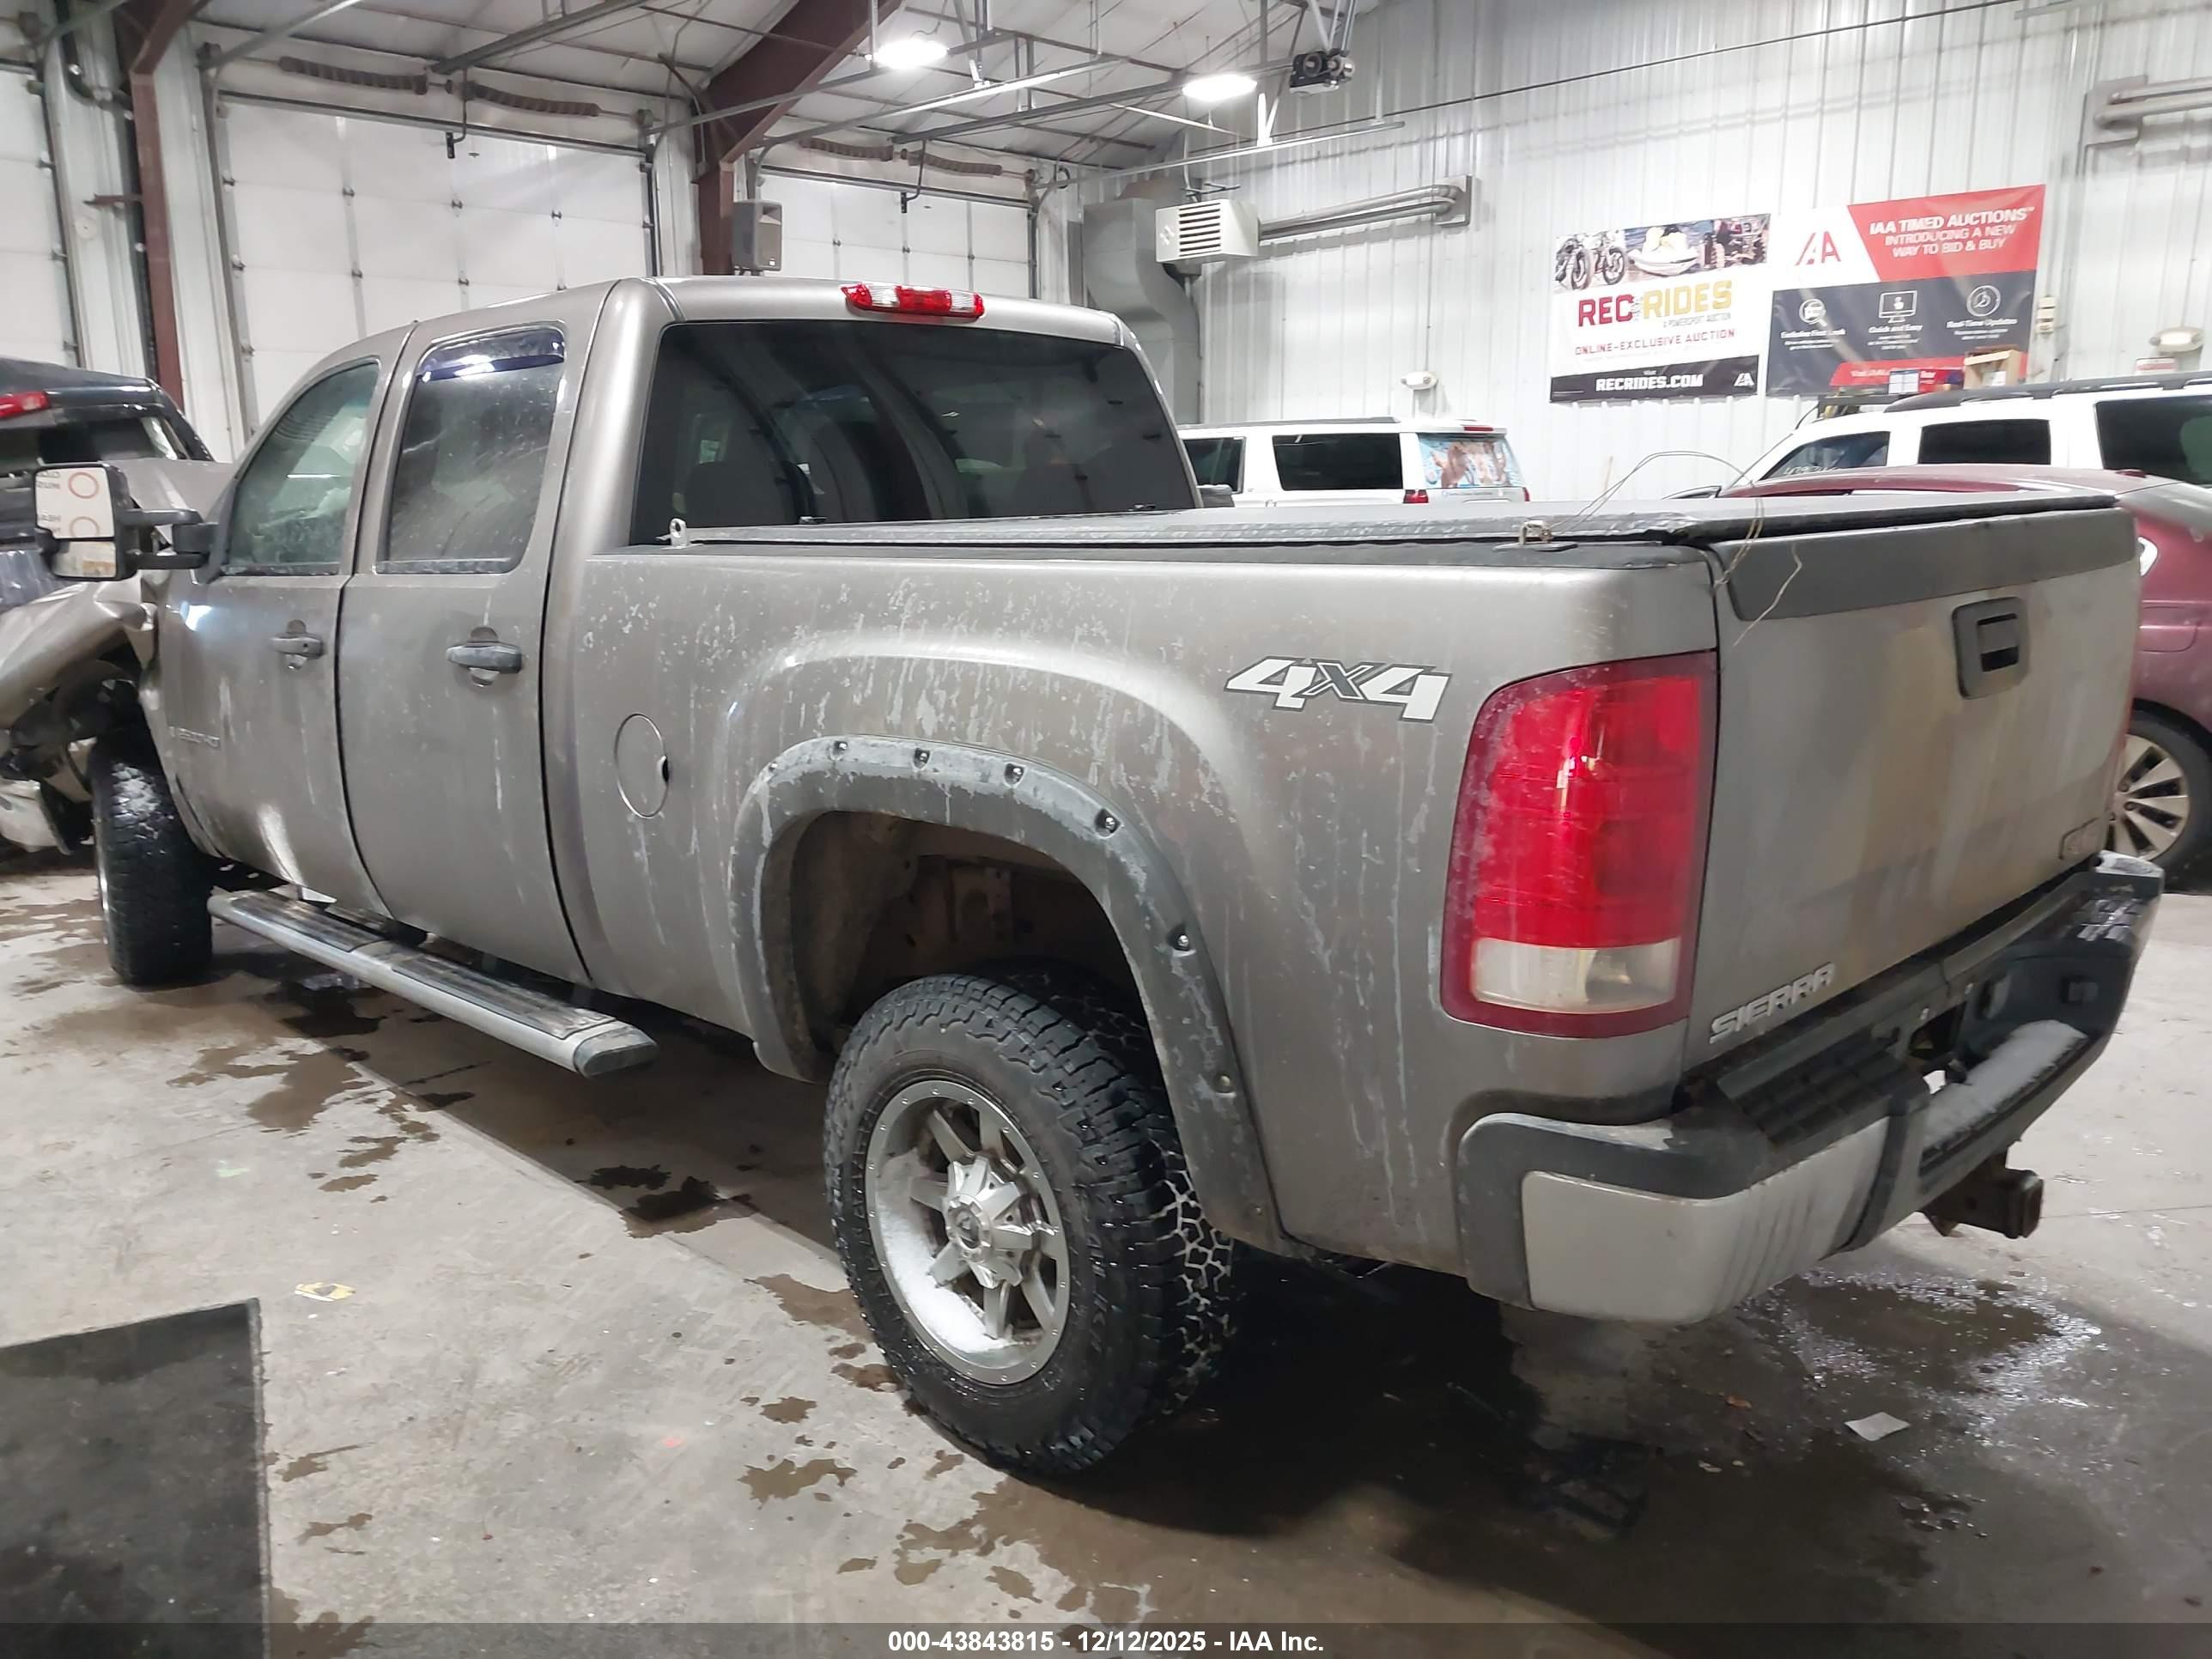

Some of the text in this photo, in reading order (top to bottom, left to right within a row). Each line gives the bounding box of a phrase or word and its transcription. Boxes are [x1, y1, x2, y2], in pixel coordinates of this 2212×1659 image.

[1869, 221, 1897, 235] IAA
[1898, 216, 1945, 232] TIMED
[1885, 224, 2017, 246] INTRODUCING A NEW
[1892, 238, 2007, 258] WAY TO BID & BUY
[1578, 279, 1733, 327] REC RIDES
[1575, 328, 1735, 356] ONLINE-EXCLUSIVE AUCTION
[1595, 374, 1704, 392] RECRIDES.COM
[1709, 962, 1836, 1044] SIERRA
